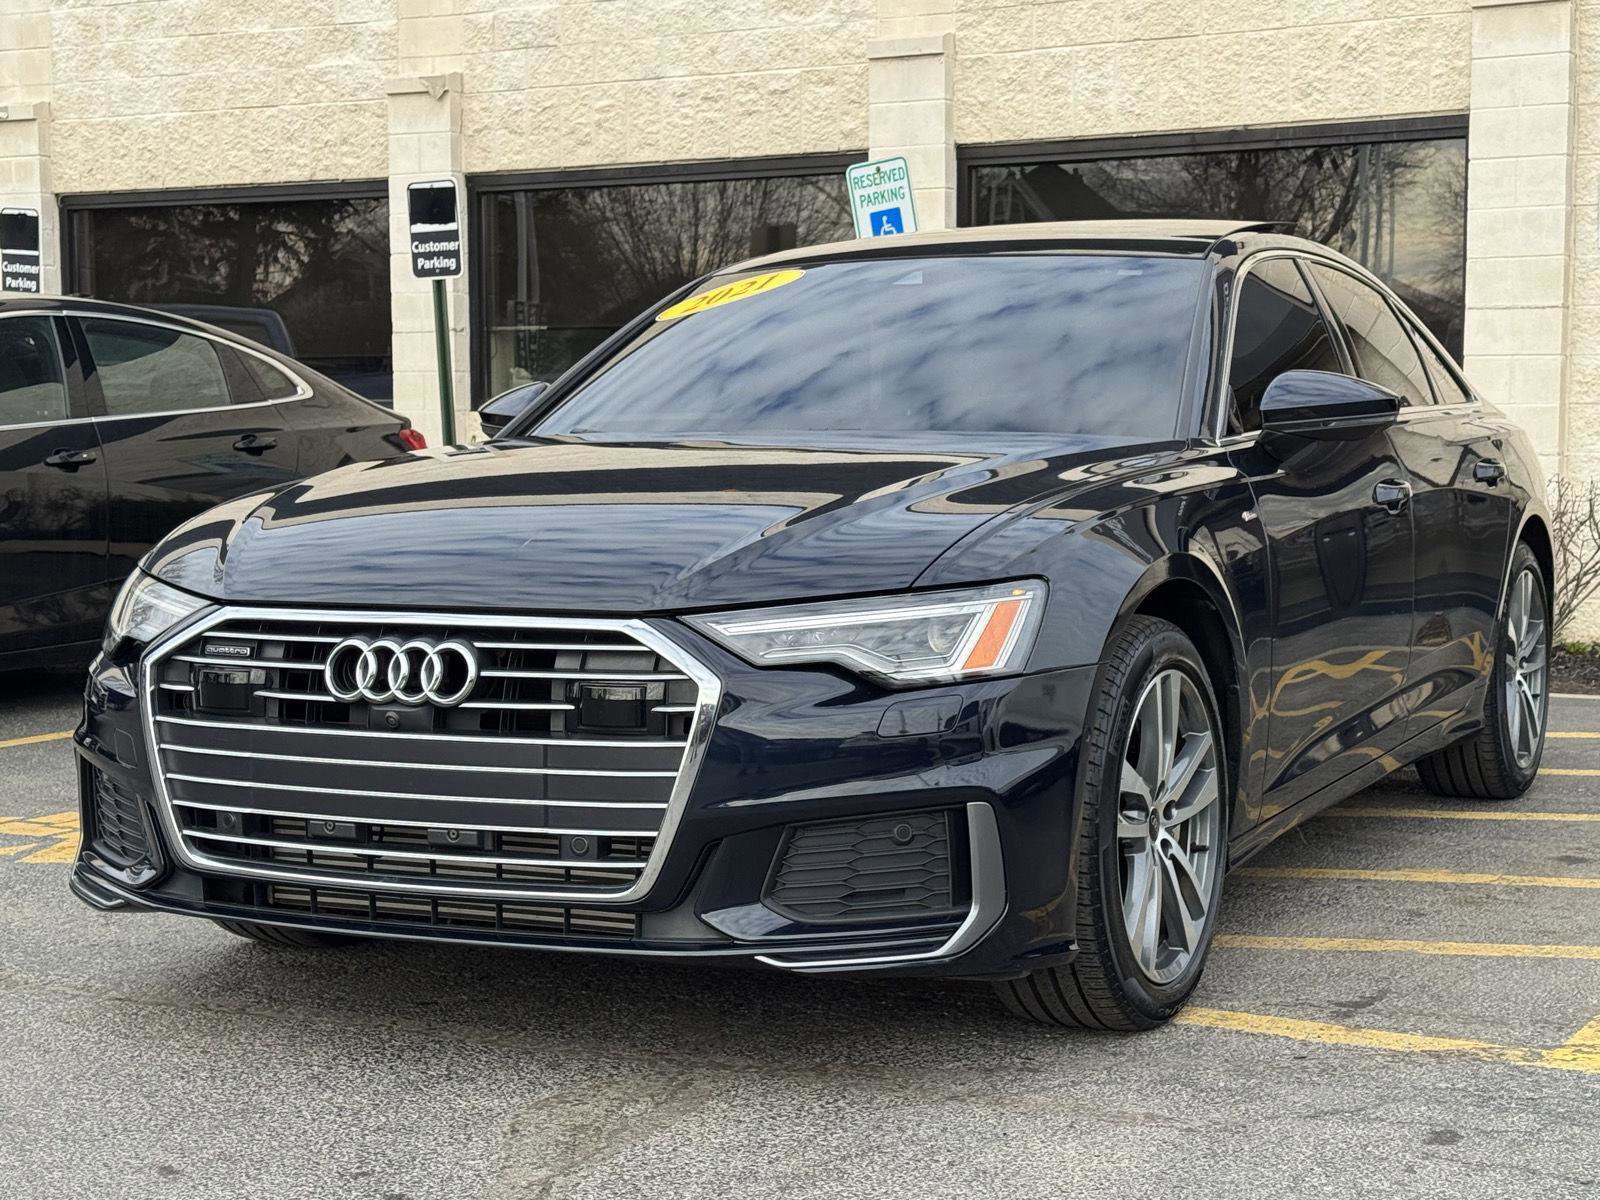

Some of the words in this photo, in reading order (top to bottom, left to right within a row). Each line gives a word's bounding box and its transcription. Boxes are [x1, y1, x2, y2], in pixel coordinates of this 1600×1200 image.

[852, 166, 906, 190] RESERVED
[859, 186, 906, 208] PARKING
[411, 241, 459, 253] Customer
[2, 261, 39, 274] Customer
[417, 256, 457, 270] Parking
[5, 277, 37, 291] Parking
[680, 273, 780, 313] 2021
[206, 647, 247, 655] quattro
